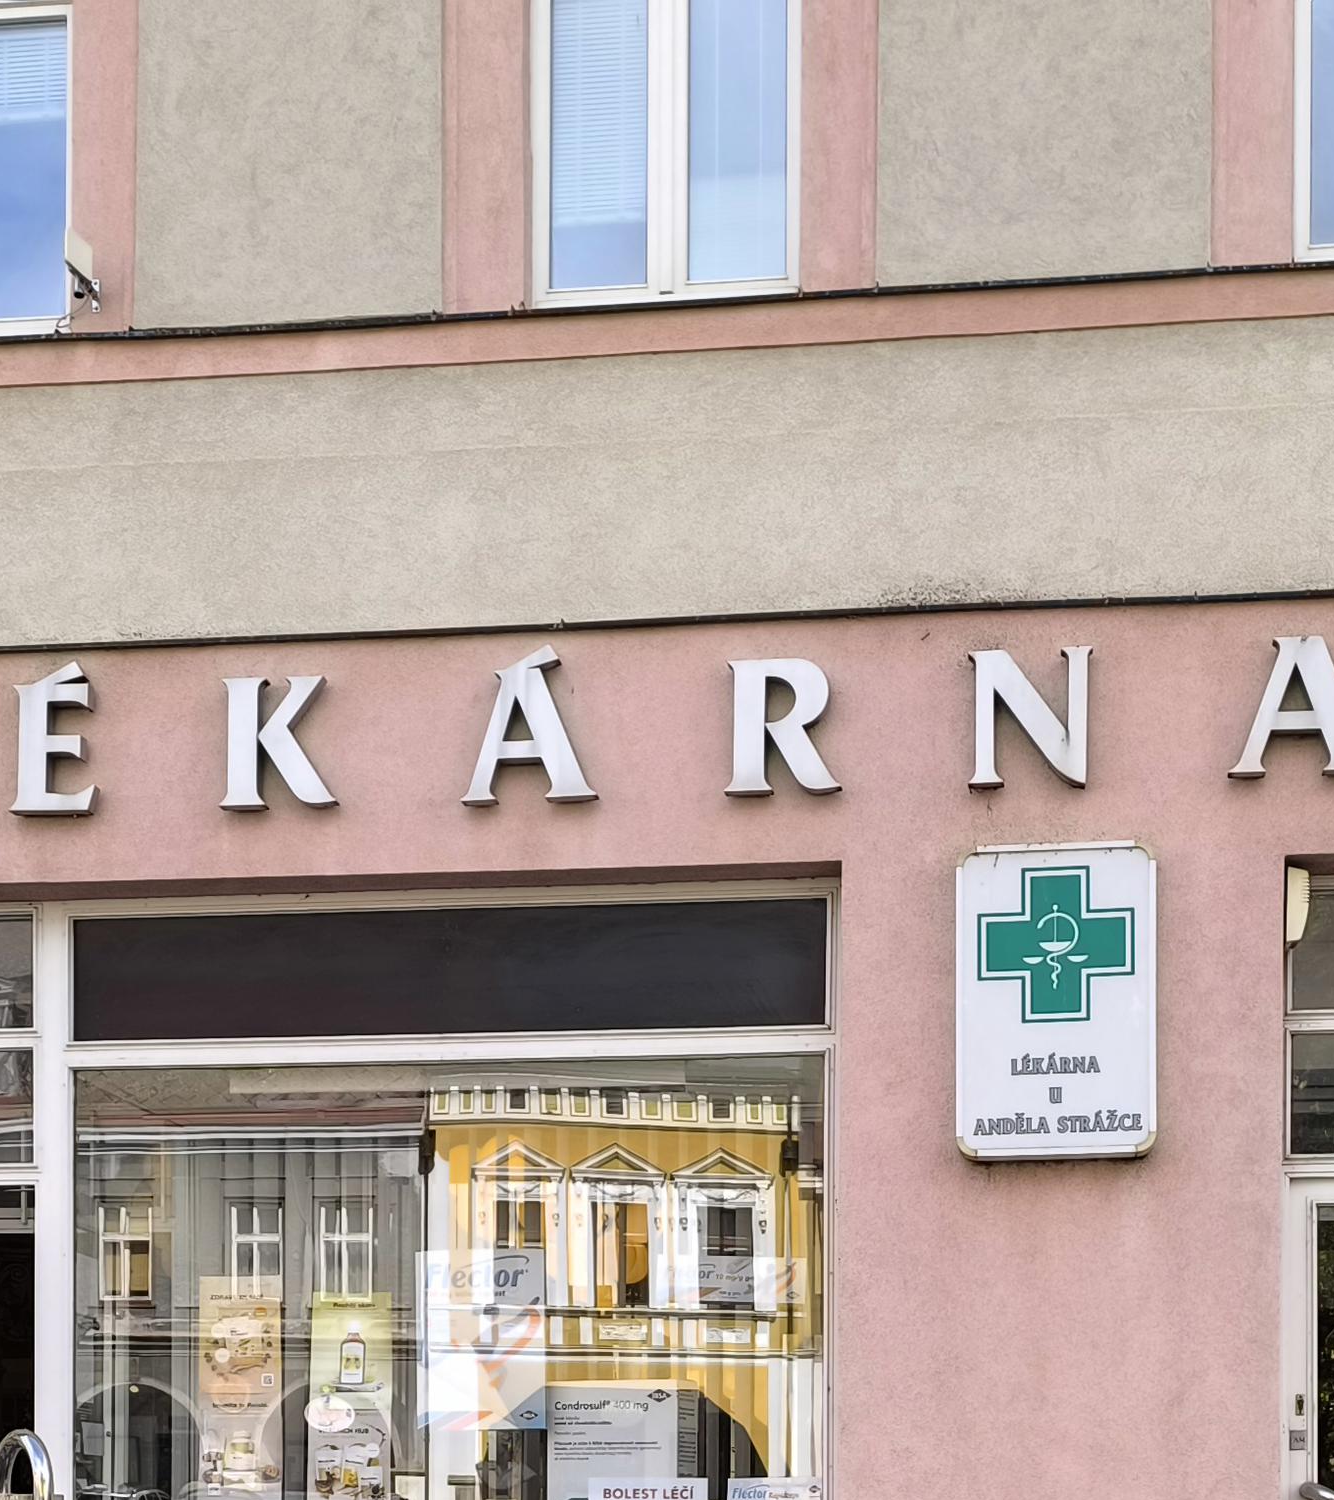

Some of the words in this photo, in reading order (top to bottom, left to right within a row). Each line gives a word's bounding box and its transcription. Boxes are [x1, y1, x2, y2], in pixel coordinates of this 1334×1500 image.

[1010, 1052, 1101, 1076] LÉKÁRNA
[973, 1113, 1051, 1136] ANDĚLA
[1057, 1109, 1143, 1133] STRÁŽCE
[633, 1402, 649, 1411] mg
[603, 1488, 658, 1500] BOLEST
[662, 1486, 694, 1500] LÉČÍ
[732, 1487, 766, 1499] Flector
